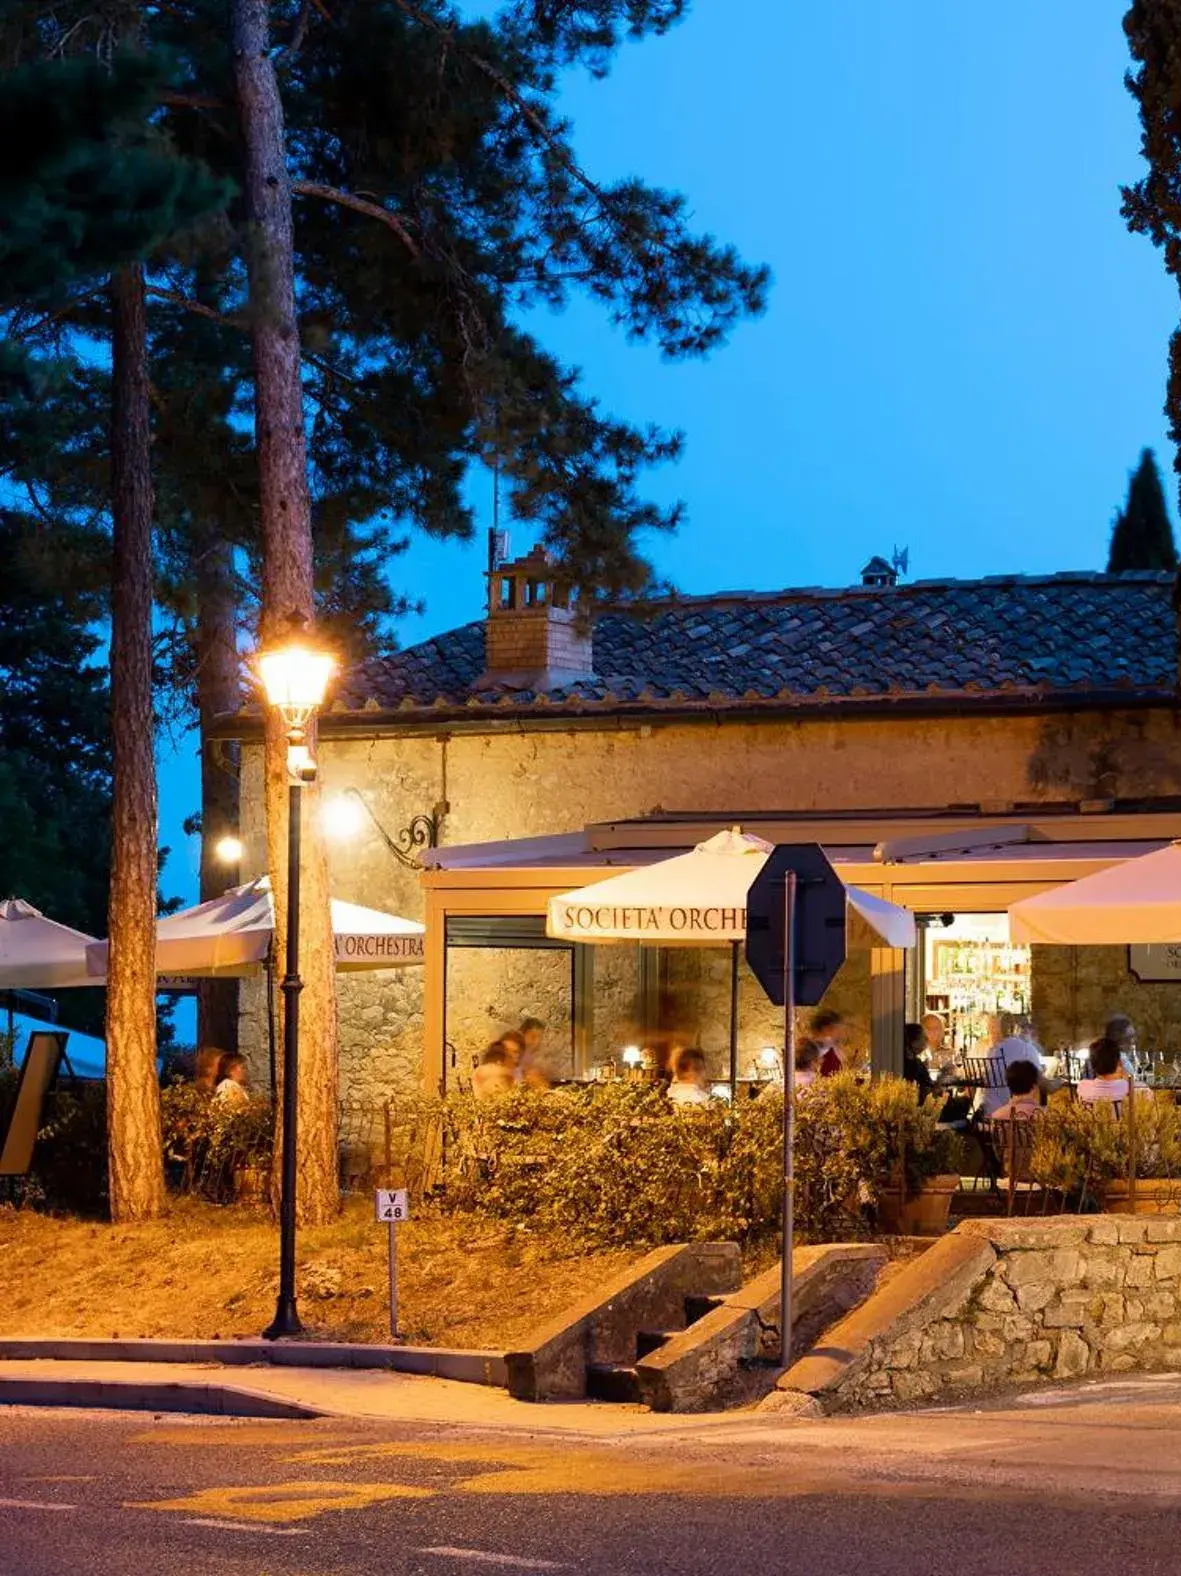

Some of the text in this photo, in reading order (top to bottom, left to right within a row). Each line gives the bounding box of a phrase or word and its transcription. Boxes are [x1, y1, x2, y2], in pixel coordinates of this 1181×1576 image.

[563, 905, 663, 930] SOCIETA'
[388, 1192, 397, 1203] V
[383, 1207, 402, 1218] 48
